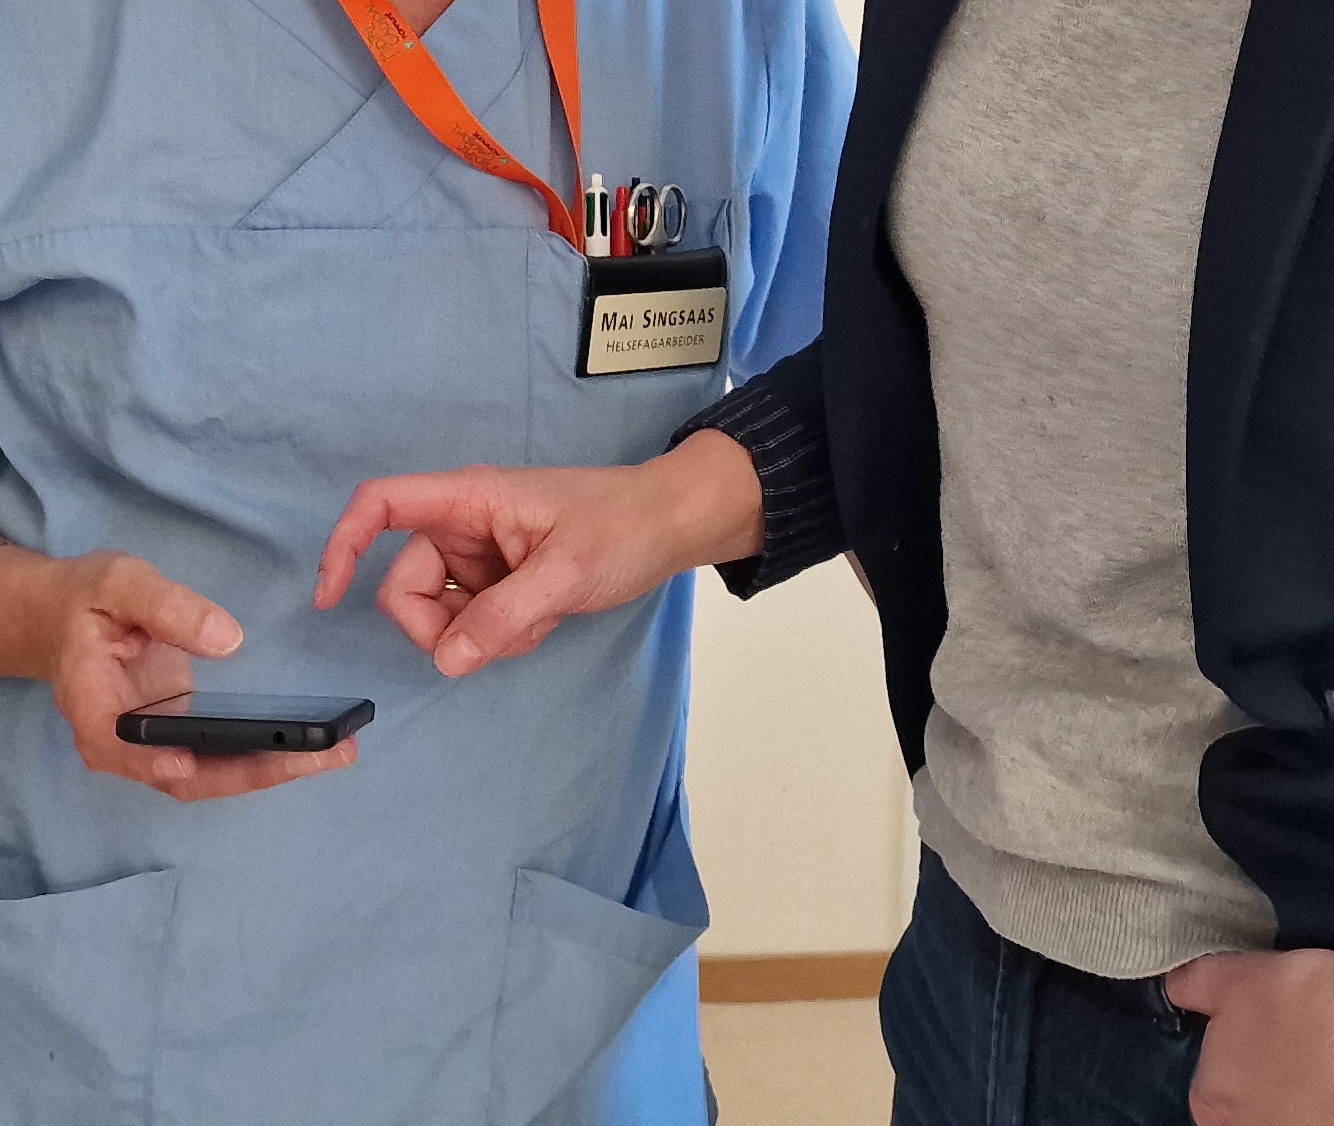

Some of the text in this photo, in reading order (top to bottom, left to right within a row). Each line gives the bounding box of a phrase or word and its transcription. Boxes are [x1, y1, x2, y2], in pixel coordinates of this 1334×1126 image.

[601, 307, 715, 332] MAI SINGSAAS
[606, 334, 705, 353] HELSEFAGARBEIDER
